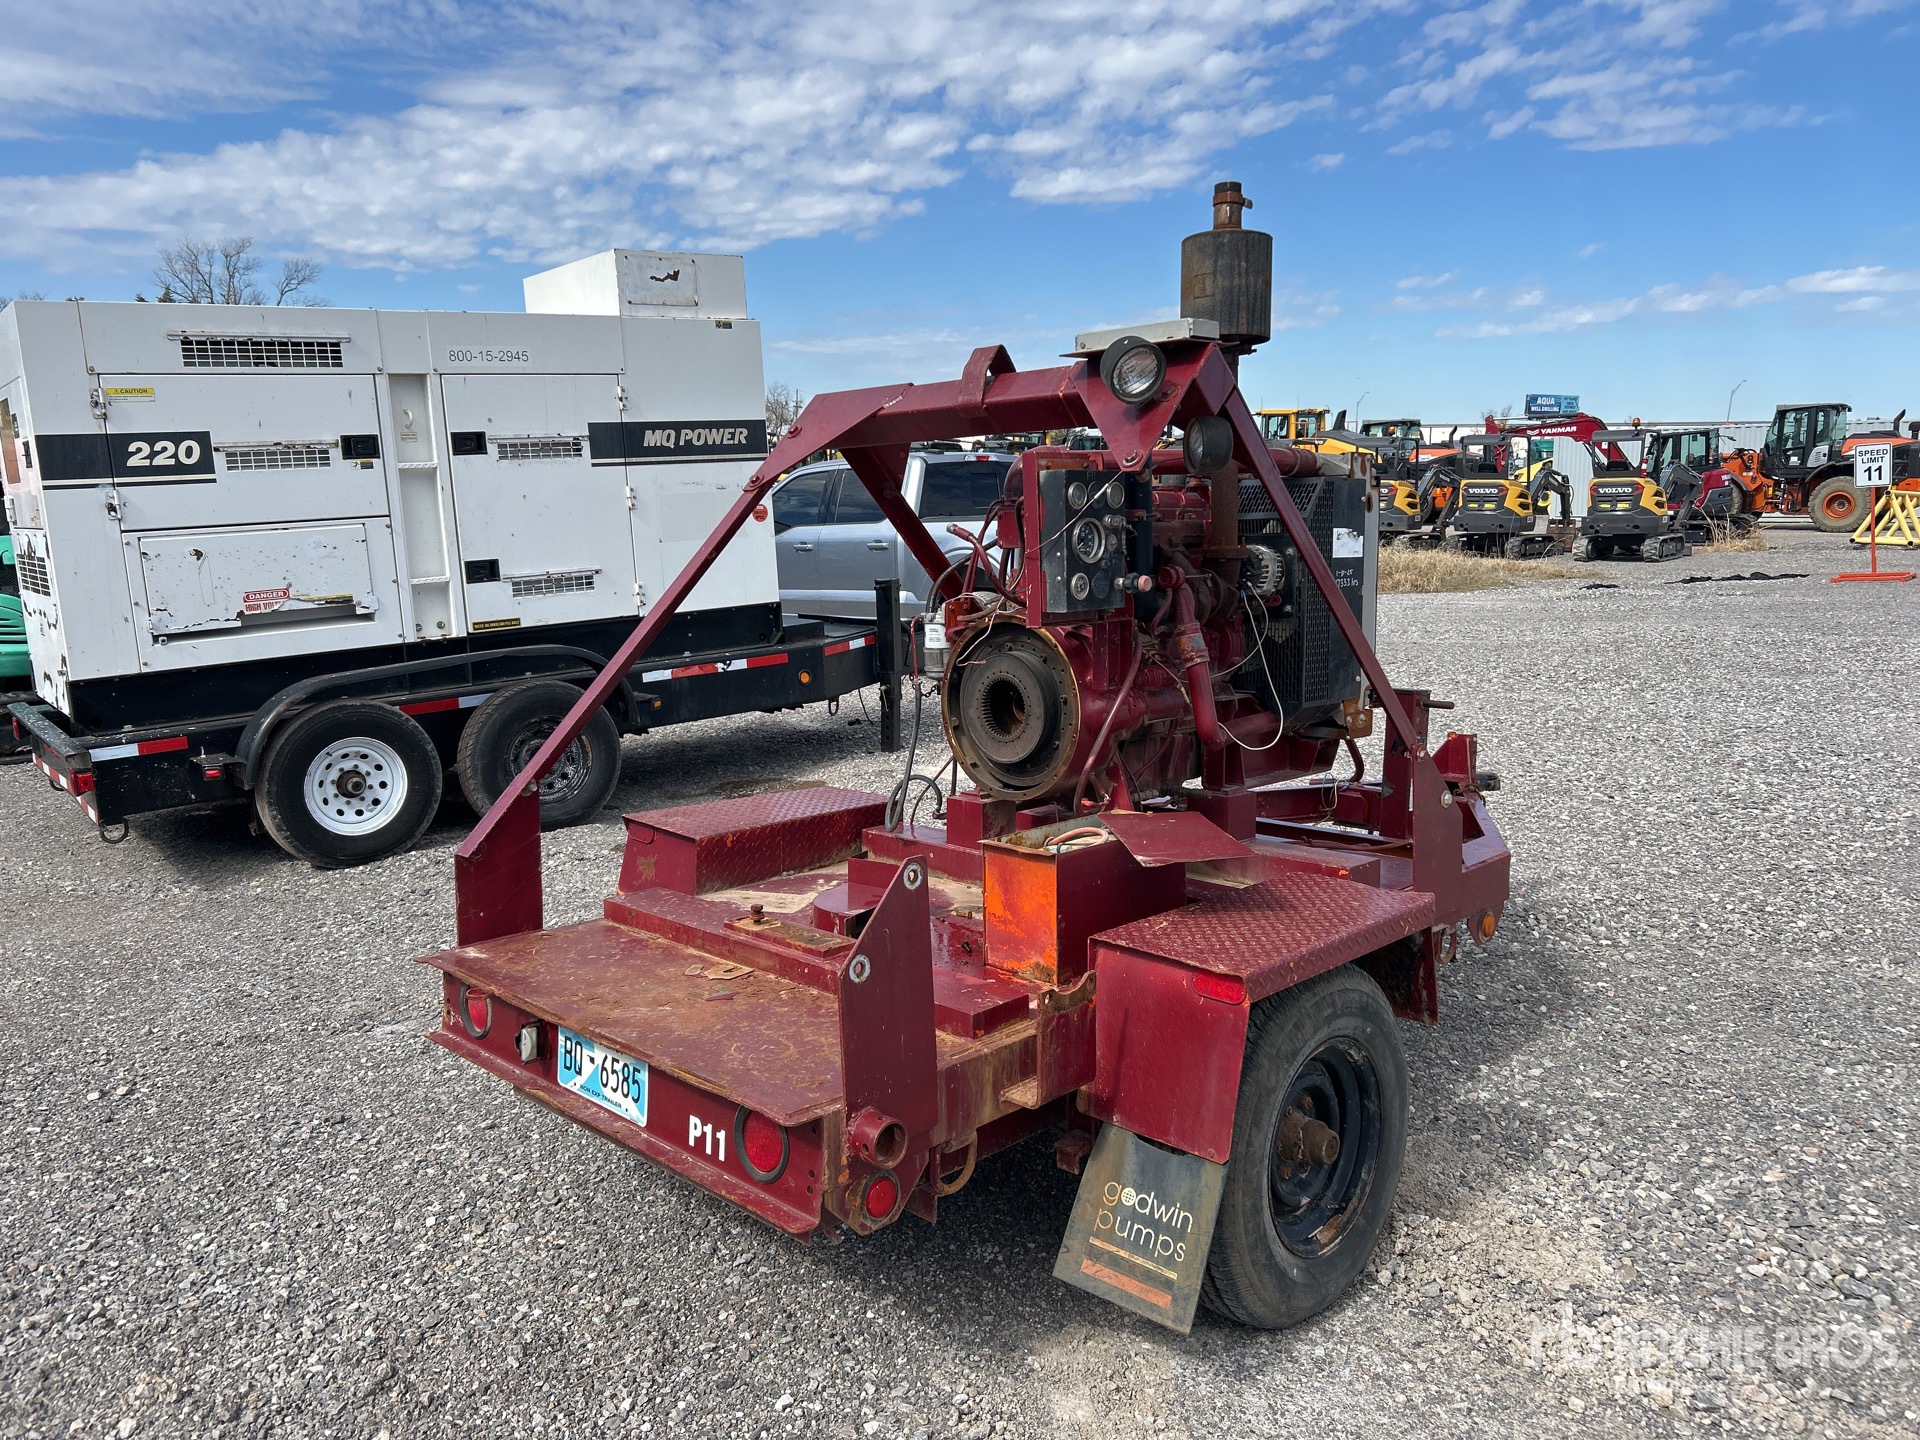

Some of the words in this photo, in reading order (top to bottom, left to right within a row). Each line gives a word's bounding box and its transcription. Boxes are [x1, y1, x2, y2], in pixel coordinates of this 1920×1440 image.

[449, 350, 529, 362] 800-15-2945
[1537, 397, 1555, 405] AQUA
[1541, 426, 1577, 434] YANMAR
[643, 429, 676, 449] MQ
[679, 428, 748, 446] POWER
[126, 439, 201, 467] 220
[1858, 449, 1889, 457] SPEED
[1861, 456, 1885, 464] LIMIT
[1863, 465, 1883, 481] 11
[249, 591, 285, 600] DANGER
[245, 603, 262, 612] HIGH
[564, 1035, 583, 1077] BQ
[600, 1054, 641, 1104] 6585
[580, 1084, 591, 1094] NON
[591, 1089, 601, 1098] EXP
[601, 1094, 622, 1109] TRAILER
[688, 1114, 726, 1162] P11
[1103, 1181, 1193, 1233] godwin
[1094, 1208, 1187, 1262] pumps
